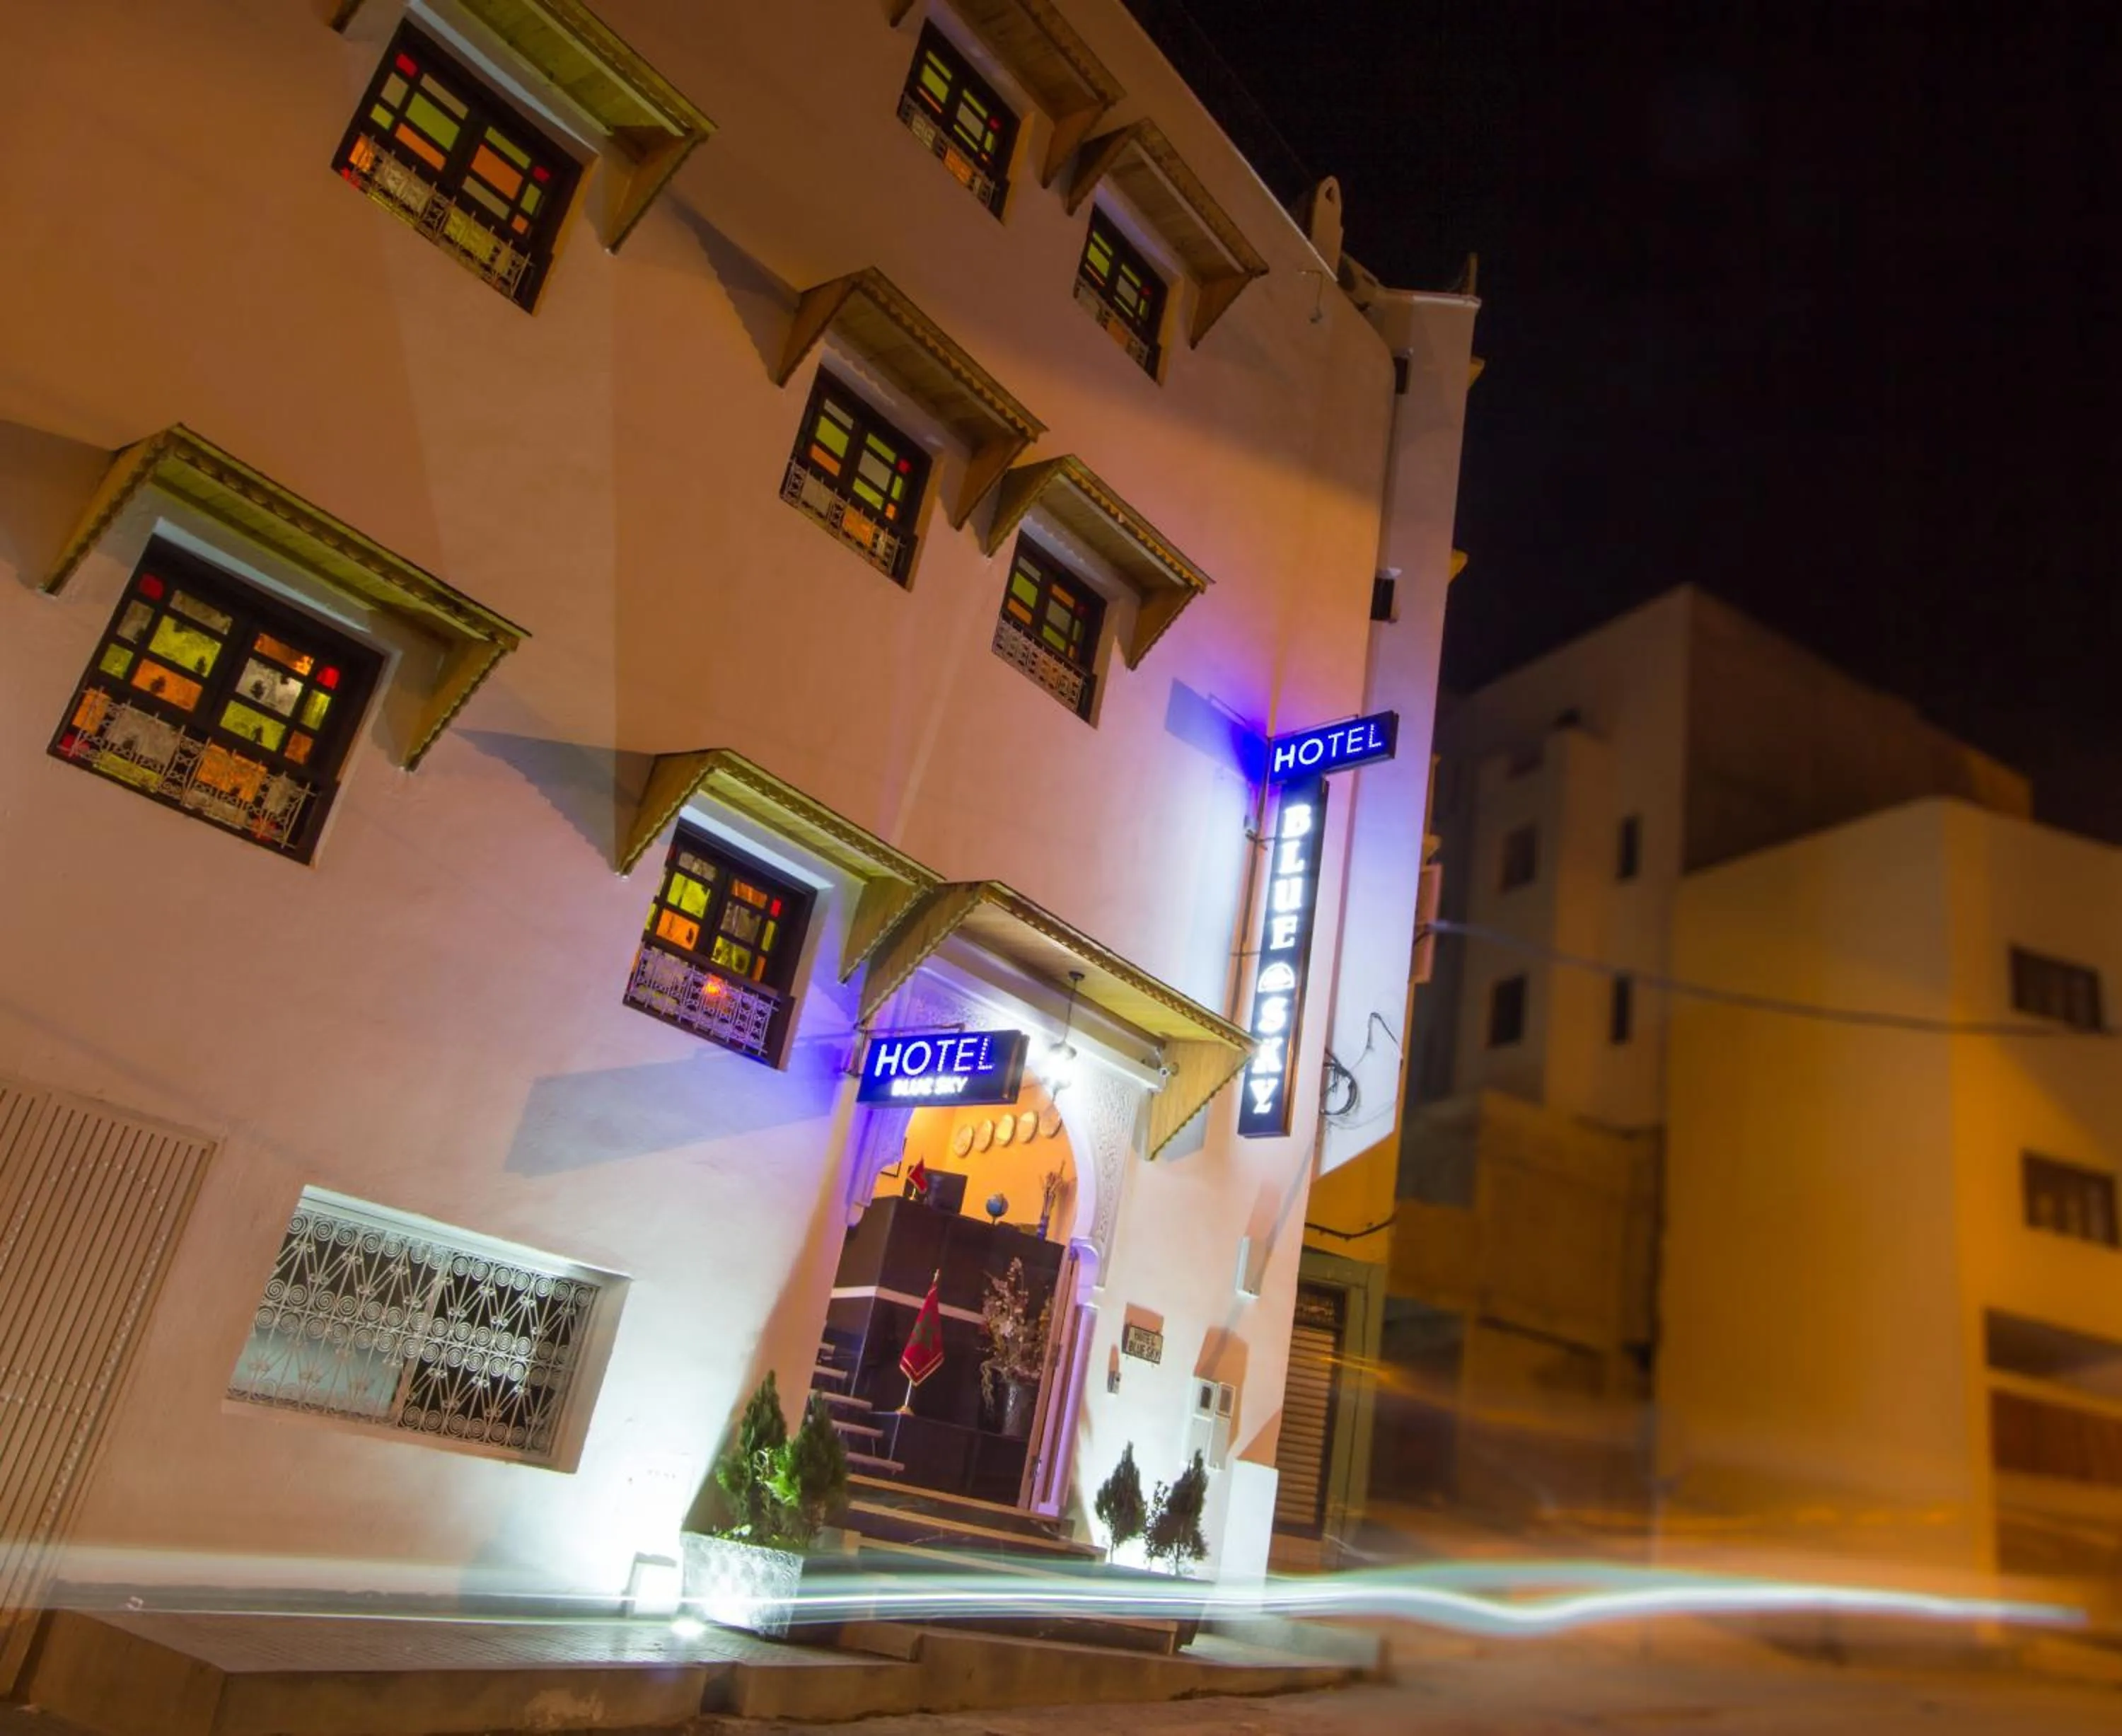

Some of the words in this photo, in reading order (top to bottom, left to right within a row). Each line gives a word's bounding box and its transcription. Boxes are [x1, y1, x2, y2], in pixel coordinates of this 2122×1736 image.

[1274, 723, 1382, 772] HOTEL
[1270, 804, 1311, 950] BLUE
[874, 1036, 994, 1077] HOTEL
[1251, 996, 1288, 1114] SKY
